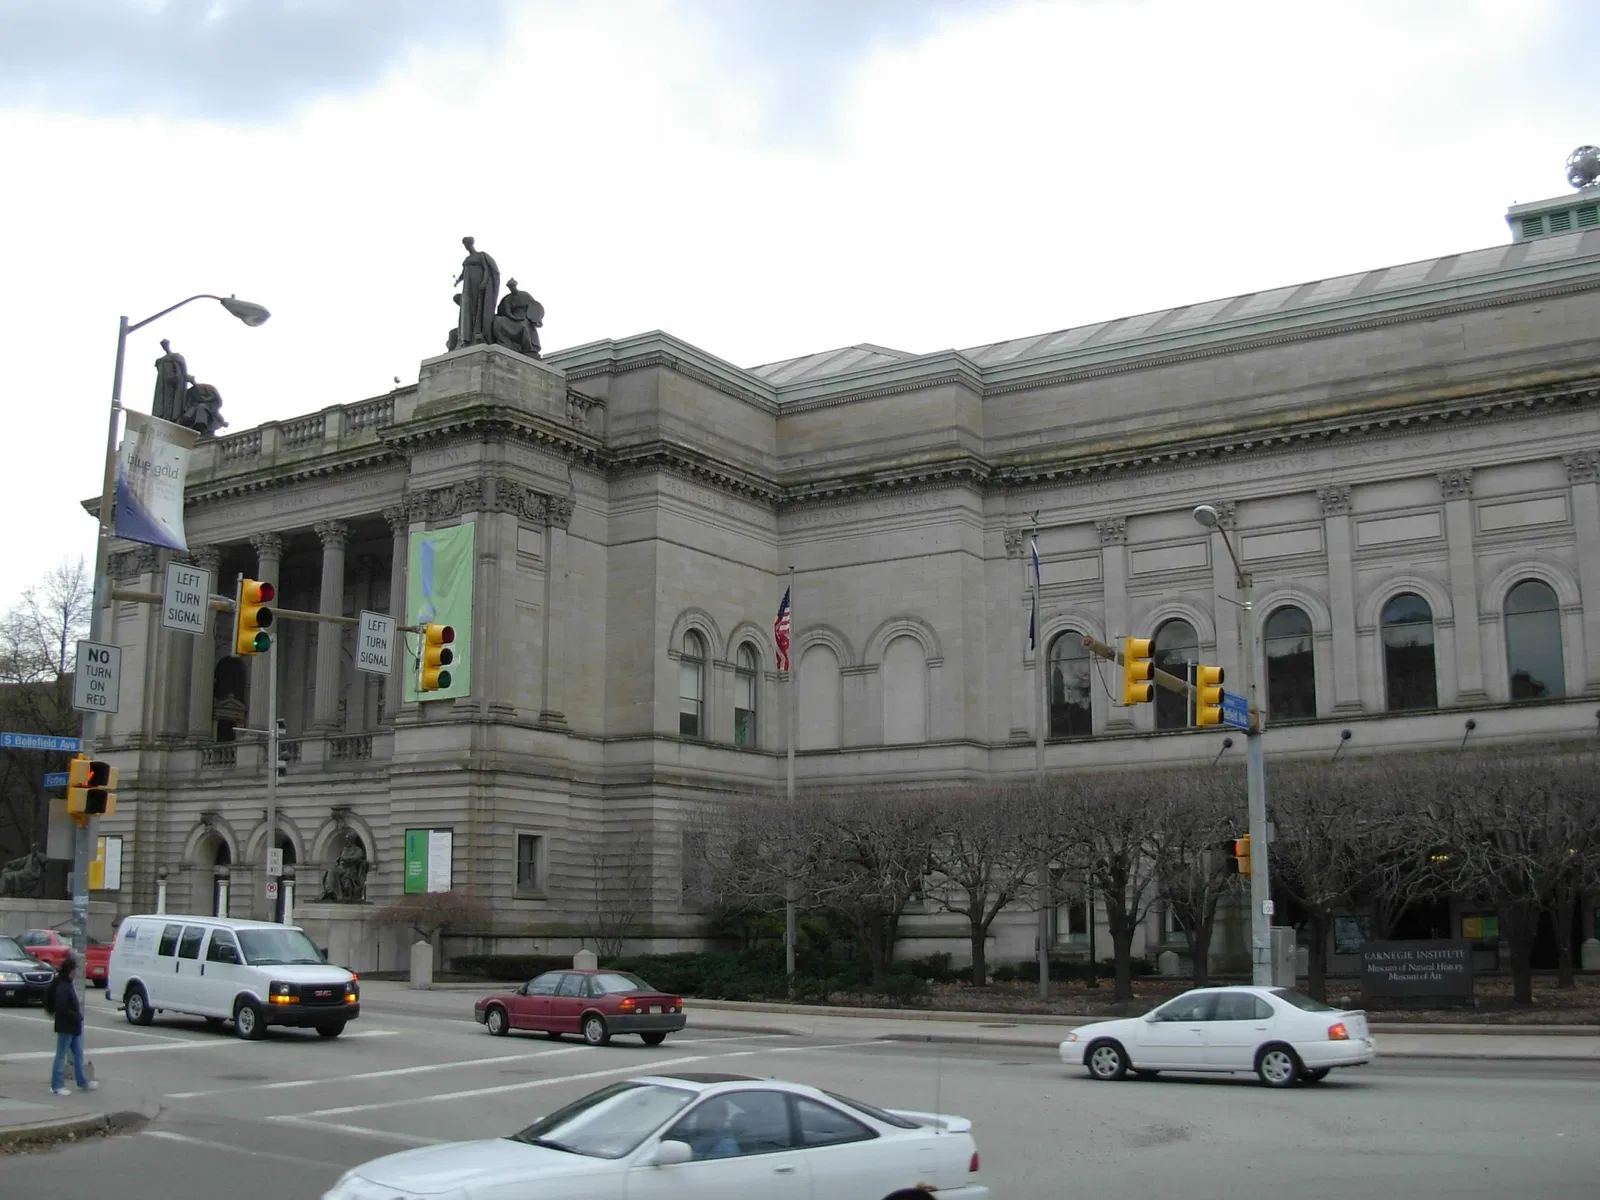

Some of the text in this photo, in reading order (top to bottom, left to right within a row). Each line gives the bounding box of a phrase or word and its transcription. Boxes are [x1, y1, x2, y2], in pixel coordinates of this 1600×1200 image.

[127, 452, 179, 480] blue gold
[177, 572, 200, 588] LEFT
[175, 590, 200, 606] TURN
[168, 608, 202, 626] SIGNAL
[368, 619, 388, 633] LEFT
[366, 635, 387, 649] TURN
[88, 648, 110, 664] NO
[360, 651, 389, 667] SIGNAL
[85, 665, 112, 679] TURN
[90, 680, 105, 692] ON
[86, 693, 107, 706] RED
[5, 735, 76, 749] S Bellefield Ave
[1364, 949, 1465, 960] CARNEGIE INSTITUTE
[1367, 962, 1463, 973] Museum of Natural History
[1388, 972, 1442, 981] Museum of Art
